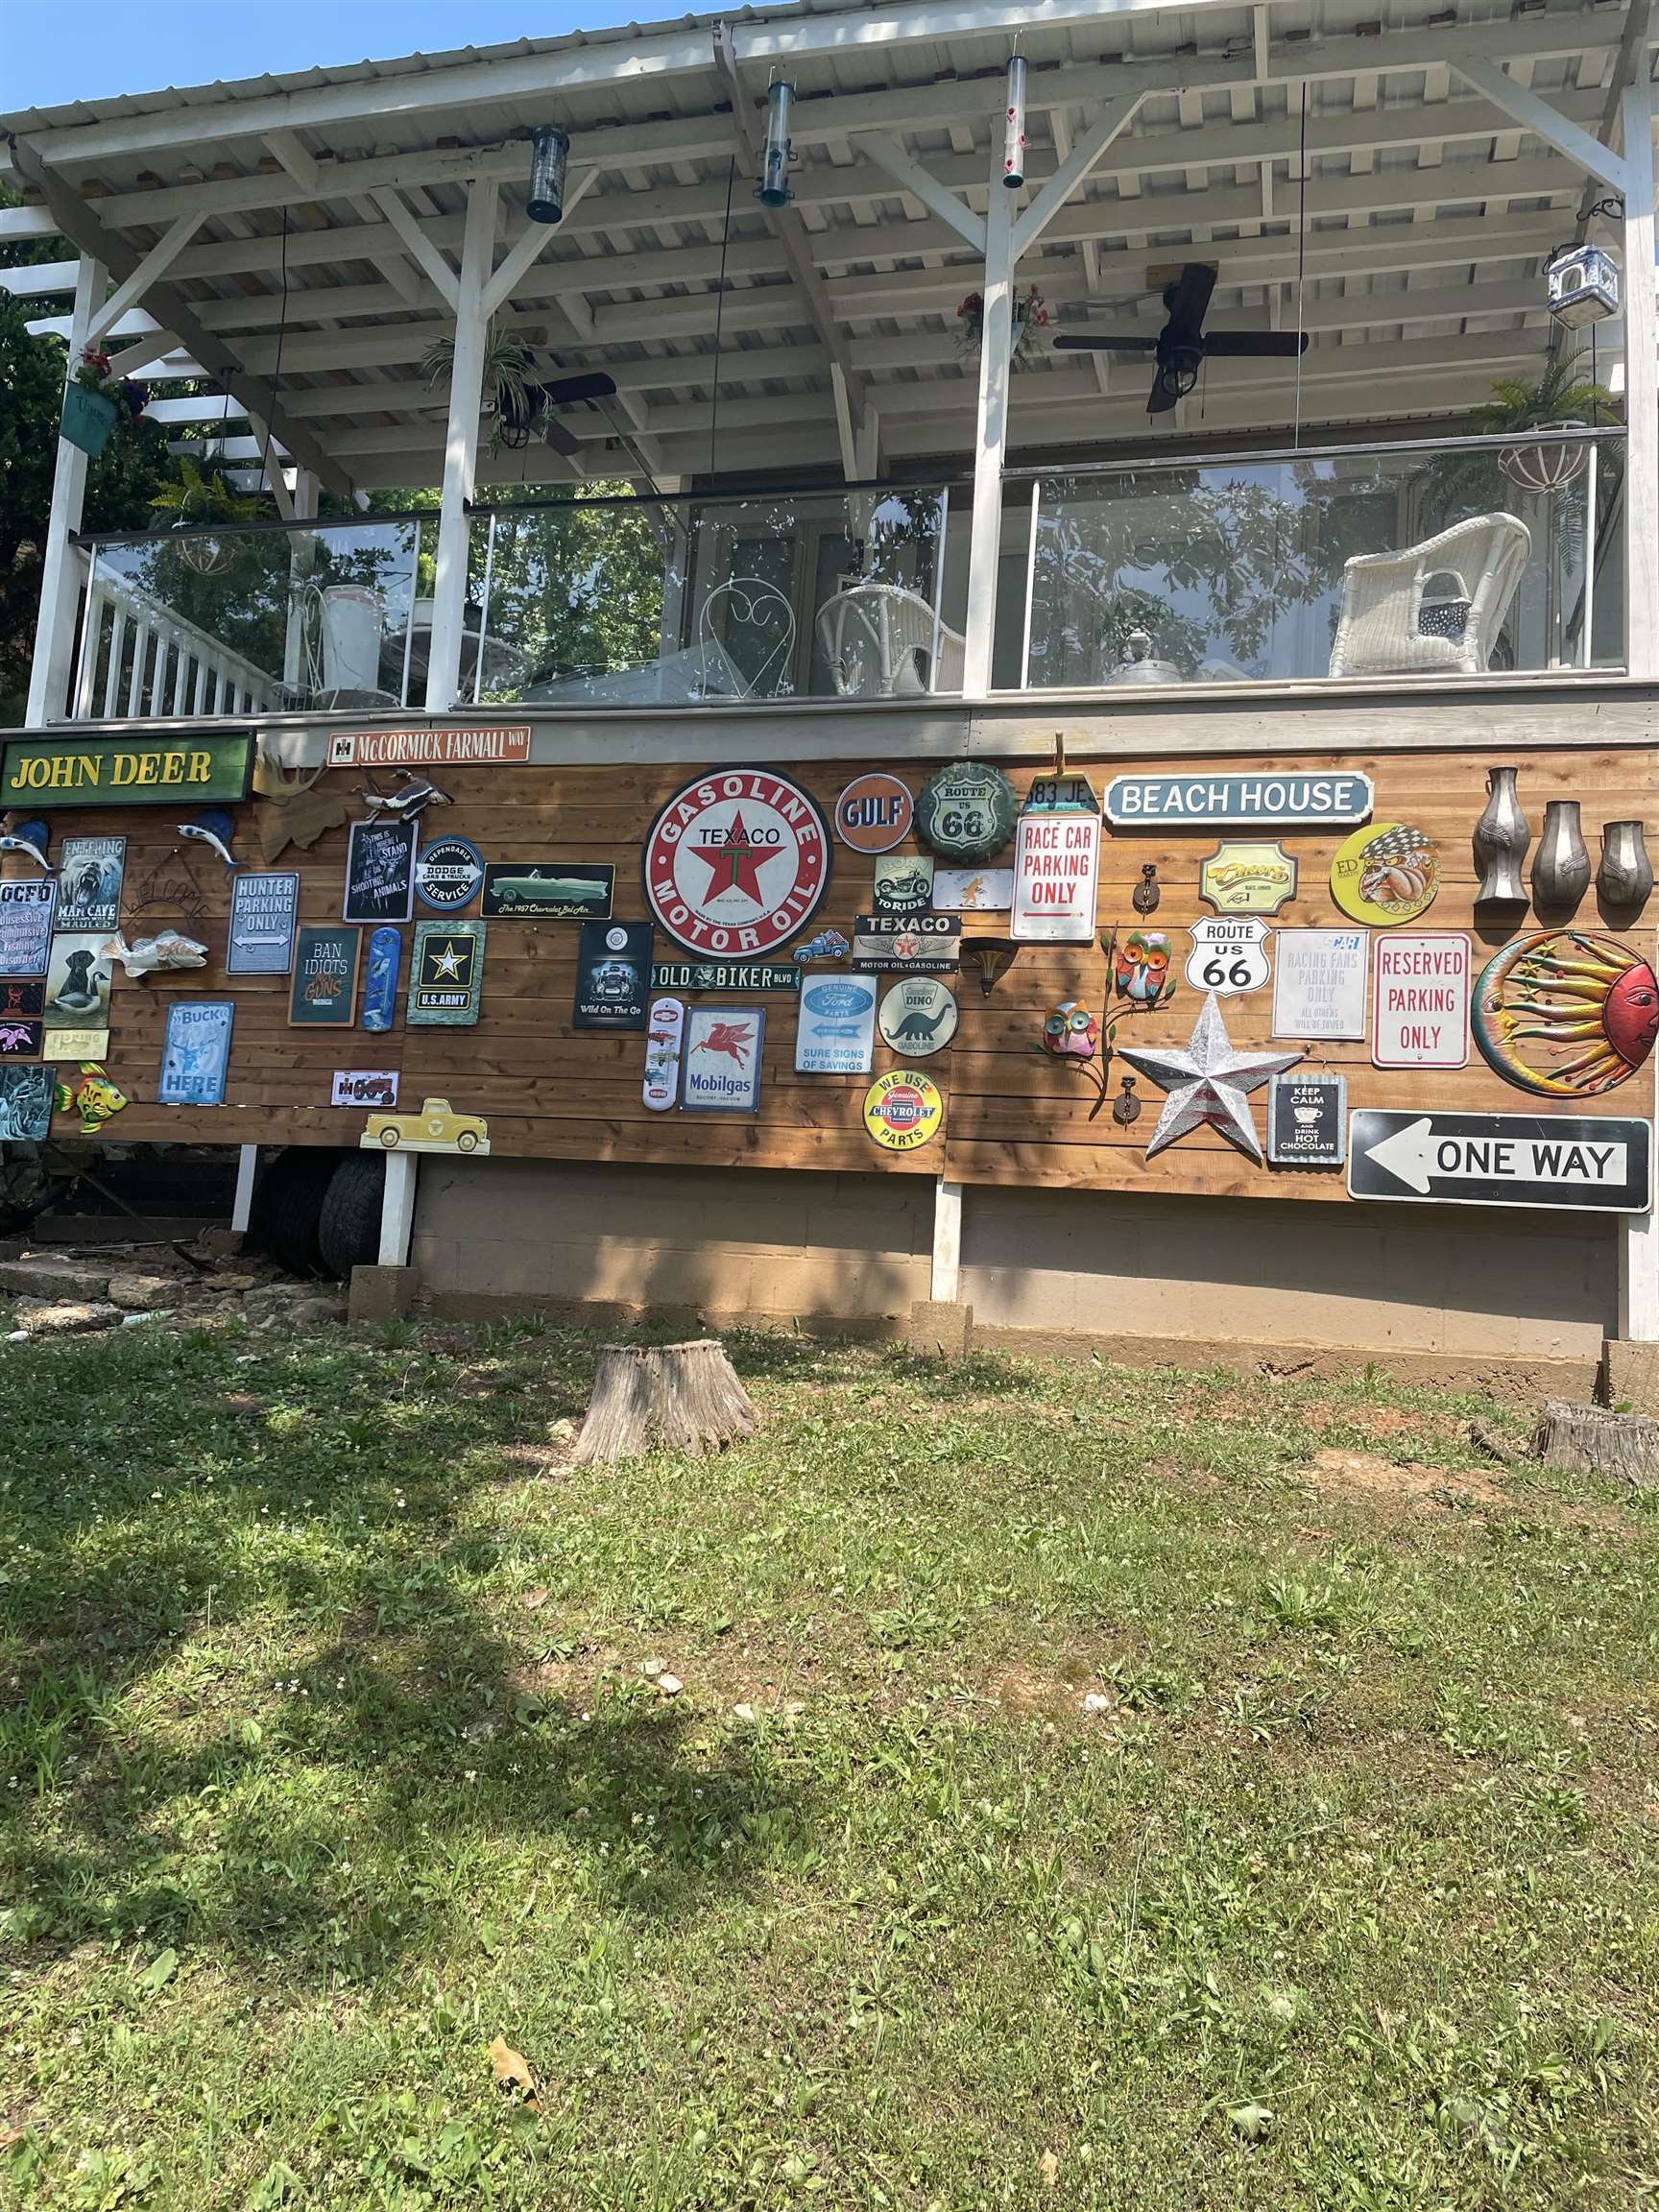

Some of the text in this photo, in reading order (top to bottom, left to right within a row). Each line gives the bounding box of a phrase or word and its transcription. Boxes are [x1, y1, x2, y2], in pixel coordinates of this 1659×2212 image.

[357, 731, 524, 761] McCORMICK FARMALL WAY
[11, 752, 211, 789] JOHN DEER
[945, 788, 987, 797] ROUTE
[1121, 781, 1354, 813] BEACH HOUSE
[660, 776, 818, 846] GASOLINE
[843, 796, 904, 828] GULF
[942, 811, 984, 837] 66
[699, 829, 780, 845] TEXACO
[1025, 827, 1092, 849] RACE CAR
[65, 841, 123, 855] ENTERING
[382, 842, 408, 859] STAND
[428, 845, 470, 861] DEPENDABLE
[1024, 855, 1090, 877] PARKING
[1335, 859, 1358, 873] ED
[239, 879, 293, 897] HUNTER
[351, 876, 384, 894] SHOOTING
[373, 879, 407, 899] ANIMALS
[425, 883, 469, 901] SERVICE
[1031, 882, 1076, 903] ONLY
[87, 904, 115, 916] CAVE
[235, 898, 292, 913] PARKING
[498, 904, 514, 913] The
[878, 898, 926, 913] TO RIDE
[654, 879, 816, 950] MOTOR OIL
[60, 920, 110, 928] MAULED
[247, 916, 278, 931] ONLY
[867, 917, 950, 932] TEXACO
[1207, 926, 1254, 938] ROUTE
[314, 943, 342, 958] BAN
[1215, 946, 1243, 955] US
[305, 960, 348, 974] IDIOTS
[1287, 952, 1358, 969] RACING FANS
[1382, 952, 1463, 975] RESERVED
[660, 967, 791, 987] OLD BIKER BLVD
[1203, 959, 1251, 987] 66
[1298, 969, 1345, 985] PARKING
[305, 979, 342, 1000] GUNS
[1308, 987, 1334, 1003] ONLY
[821, 994, 854, 1006] Ford
[906, 997, 932, 1005] DINO
[1388, 990, 1455, 1012] PARKING
[182, 1010, 219, 1024] BUCK
[581, 1005, 599, 1014] Wild
[1401, 1026, 1441, 1048] ONLY
[803, 1048, 864, 1059] SURE SIGNS
[898, 1042, 934, 1050] GASOLINE
[803, 1060, 862, 1070] OF SAVINGS
[167, 1075, 217, 1092] HERE
[689, 1074, 751, 1095] Mobilgas
[879, 1073, 929, 1093] WE USE
[1294, 1087, 1320, 1095] KEEP
[888, 1090, 919, 1099] Genuine
[873, 1106, 932, 1118] CHEVROLET
[880, 1128, 924, 1145] PARTS
[1437, 1141, 1616, 1179] ONE WAY
